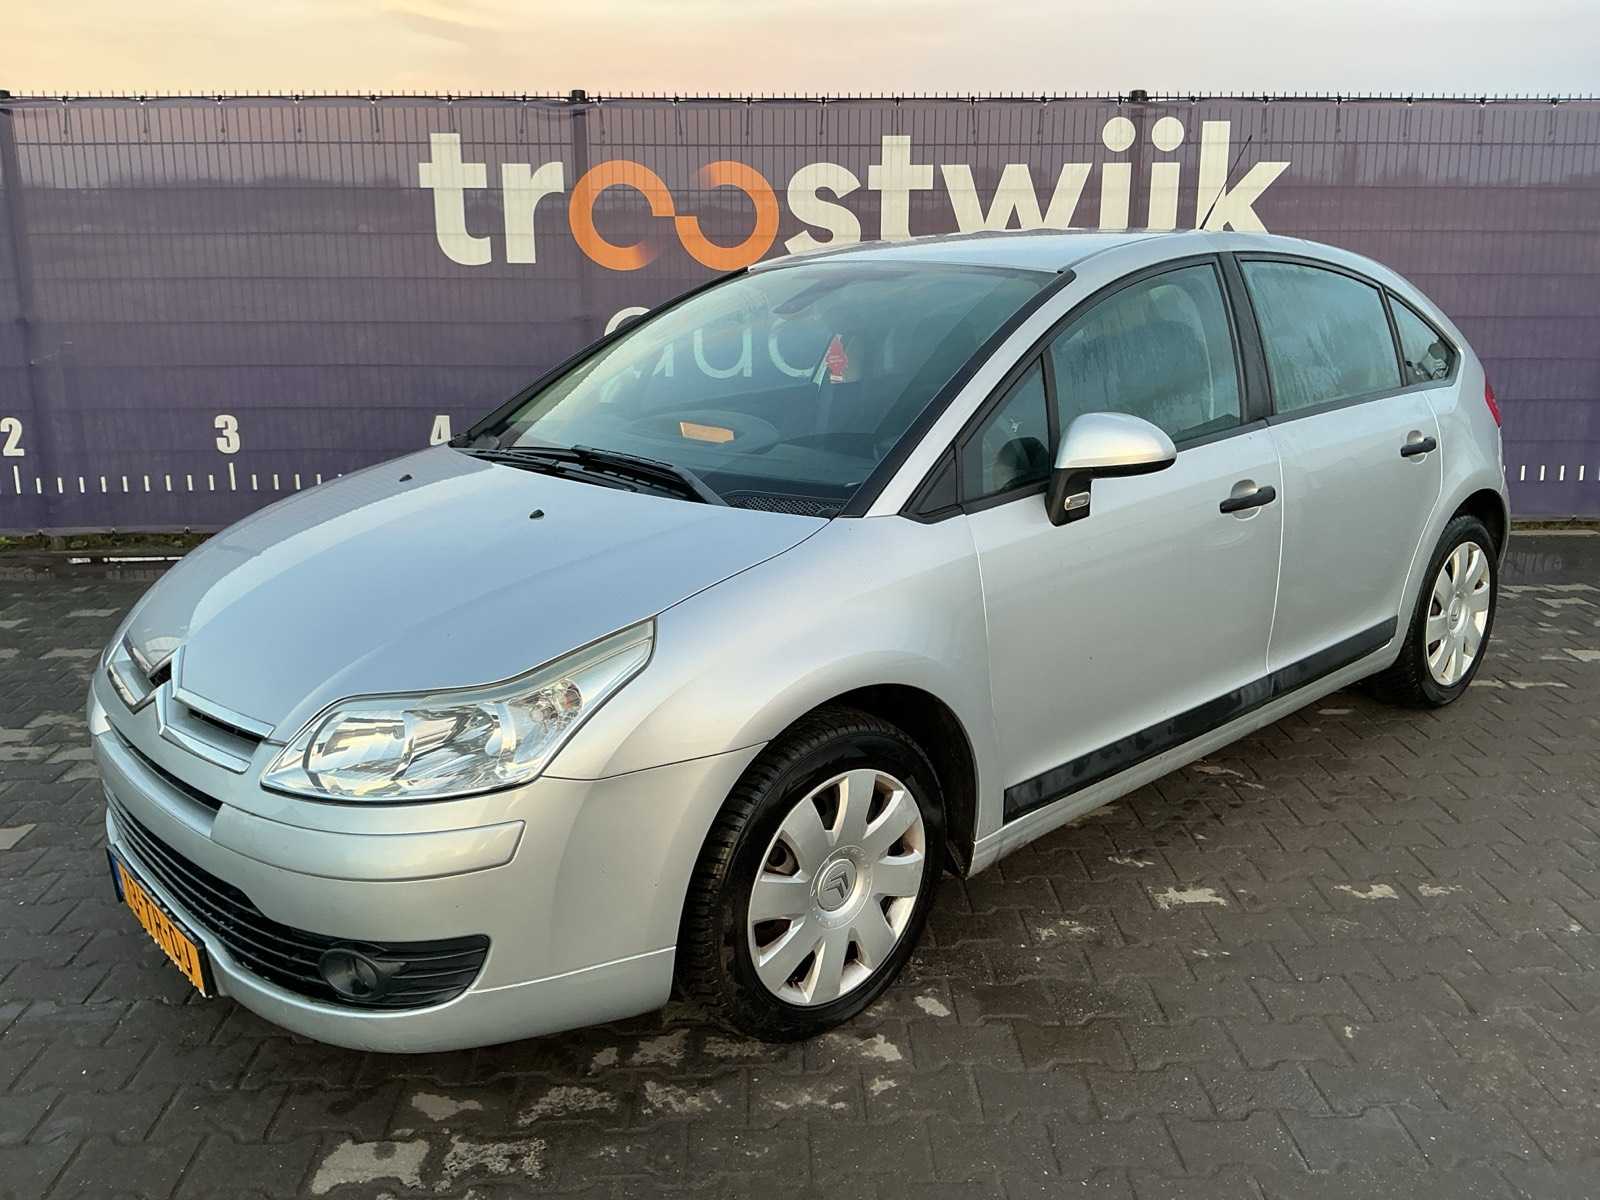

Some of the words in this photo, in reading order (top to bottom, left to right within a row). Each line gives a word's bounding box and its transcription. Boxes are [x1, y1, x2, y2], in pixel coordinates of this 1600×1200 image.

[1, 417, 25, 457] 2
[214, 414, 241, 454] 3
[430, 415, 451, 446] 4
